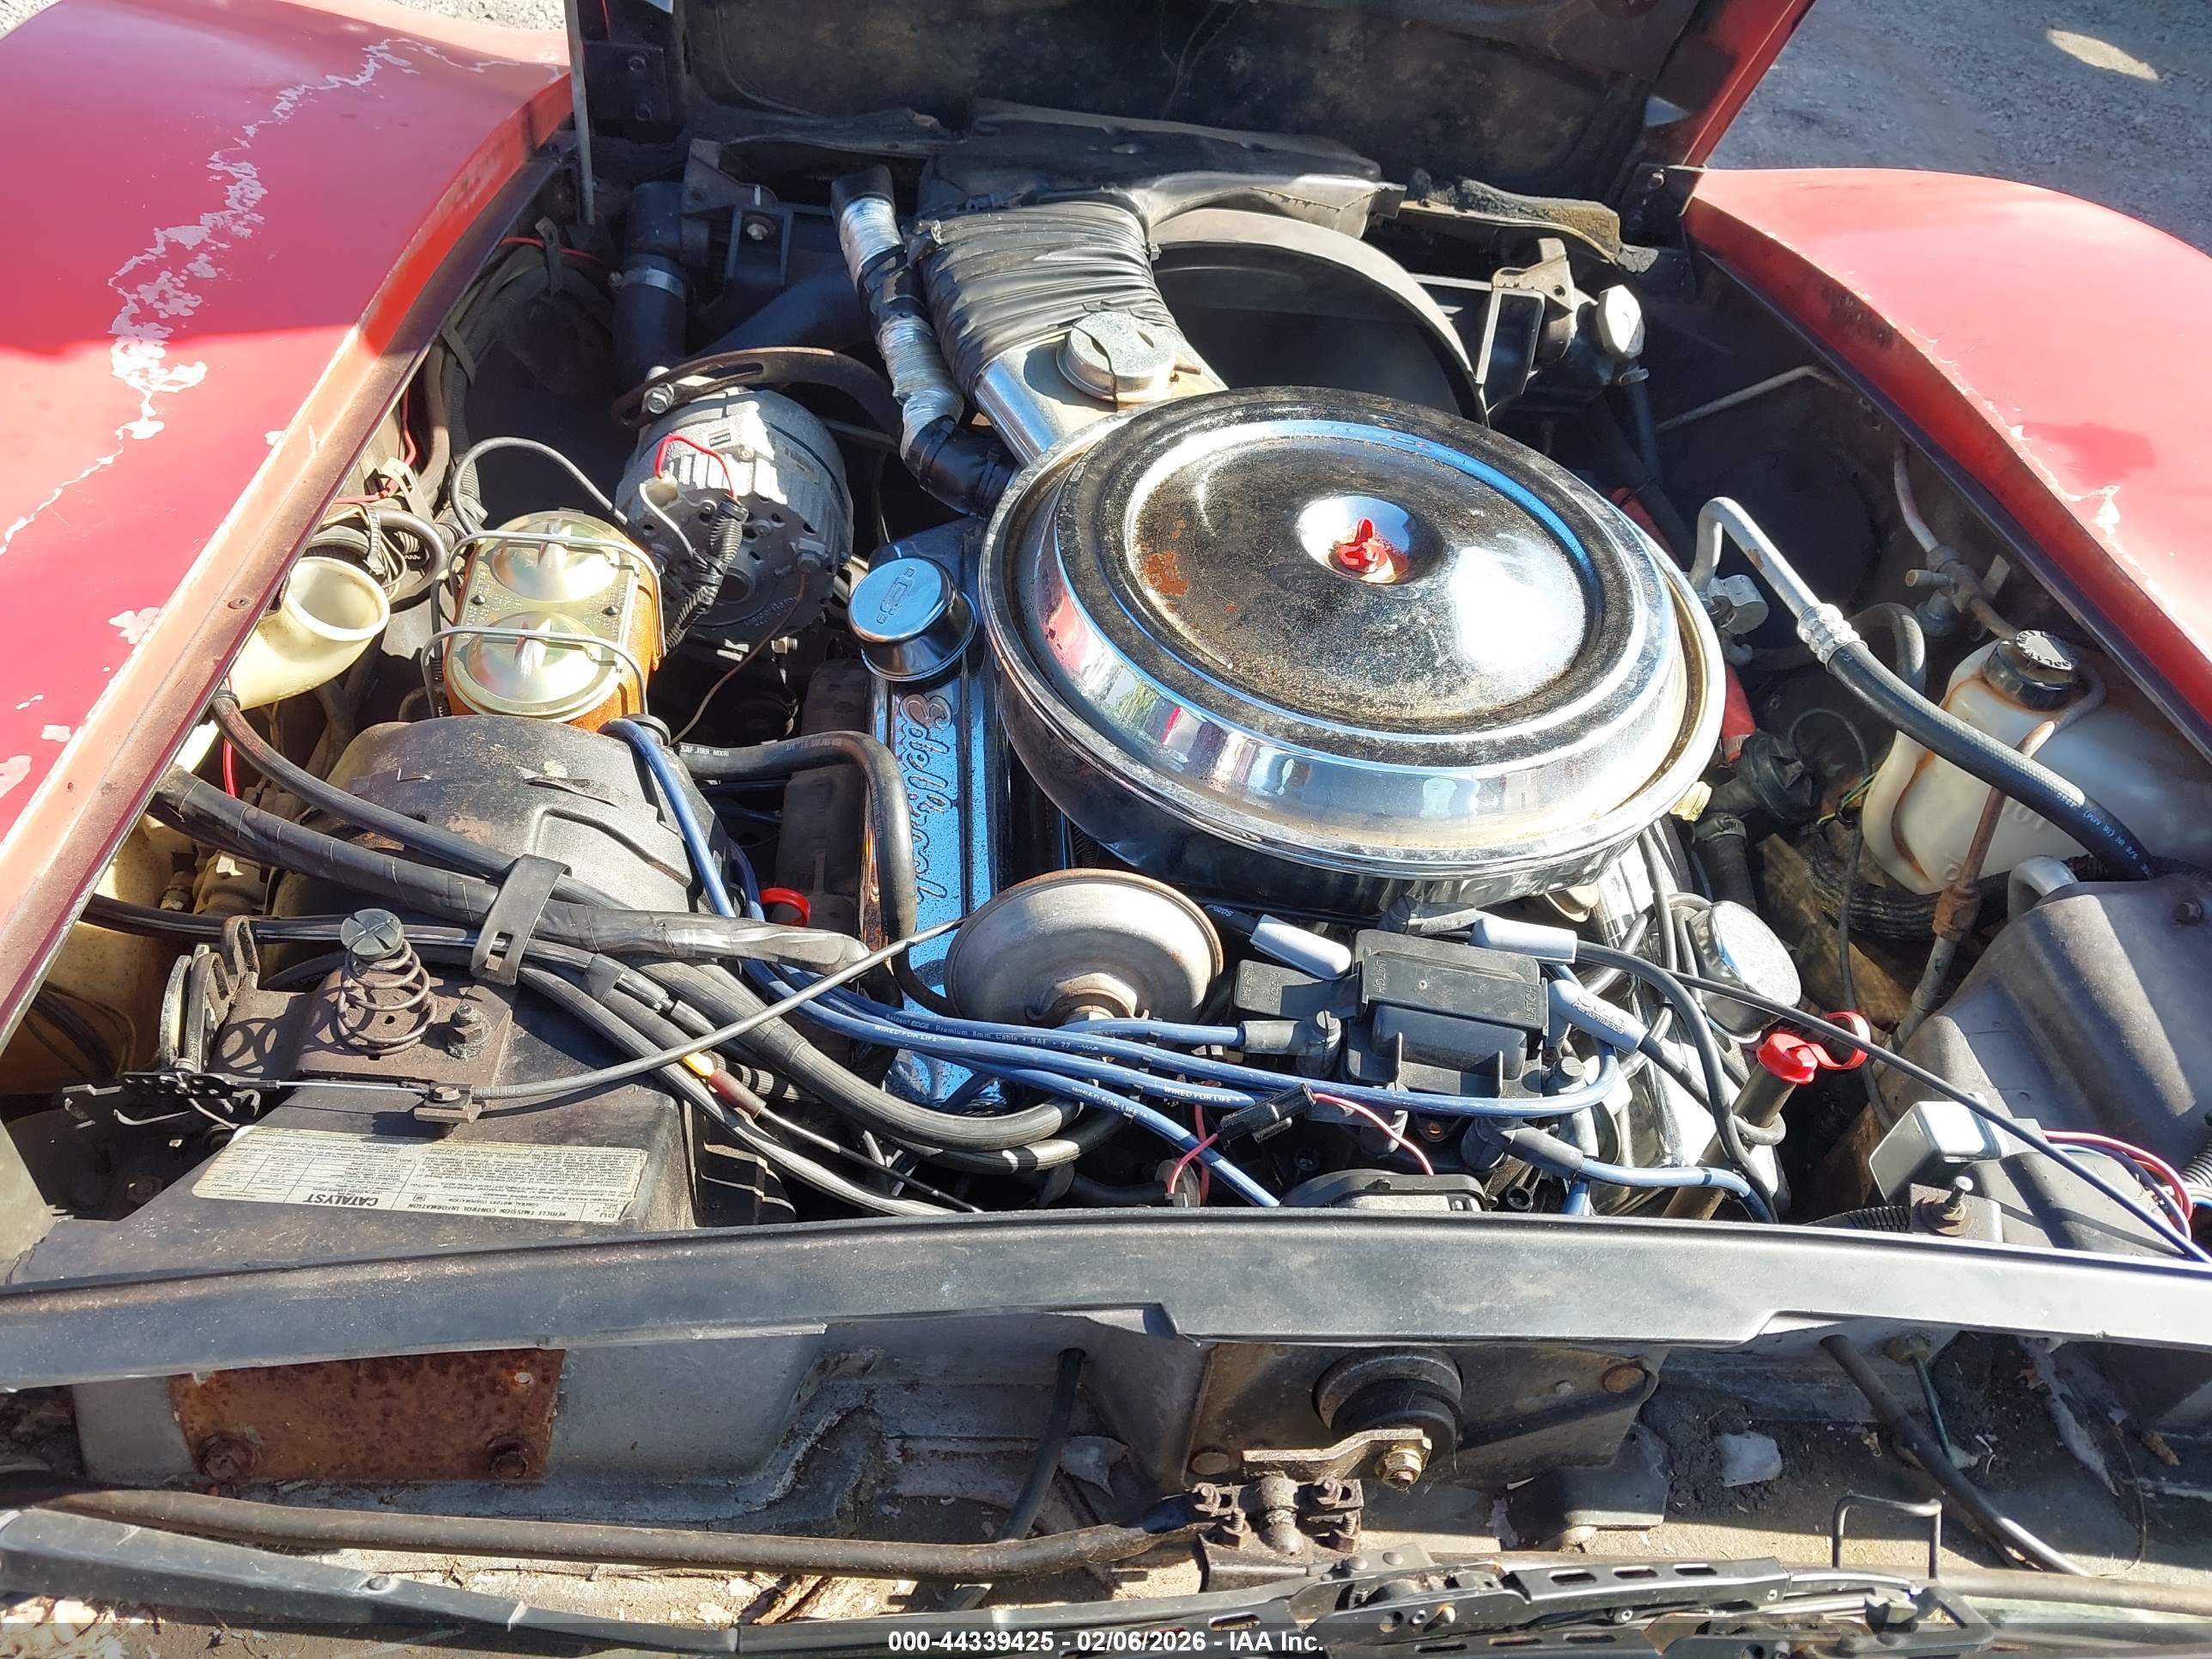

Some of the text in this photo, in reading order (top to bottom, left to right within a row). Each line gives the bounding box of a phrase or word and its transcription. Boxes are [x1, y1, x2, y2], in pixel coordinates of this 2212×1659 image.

[1524, 985, 1538, 1022] LATCH
[935, 1024, 968, 1036] Premium
[1164, 1085, 1194, 1098] WIRED
[1194, 1091, 1213, 1101] FOR
[1102, 1096, 1119, 1109] FOR
[303, 1193, 379, 1206] CATALYST
[408, 1203, 459, 1212] INFORMATION
[463, 1206, 495, 1214] CONTROL
